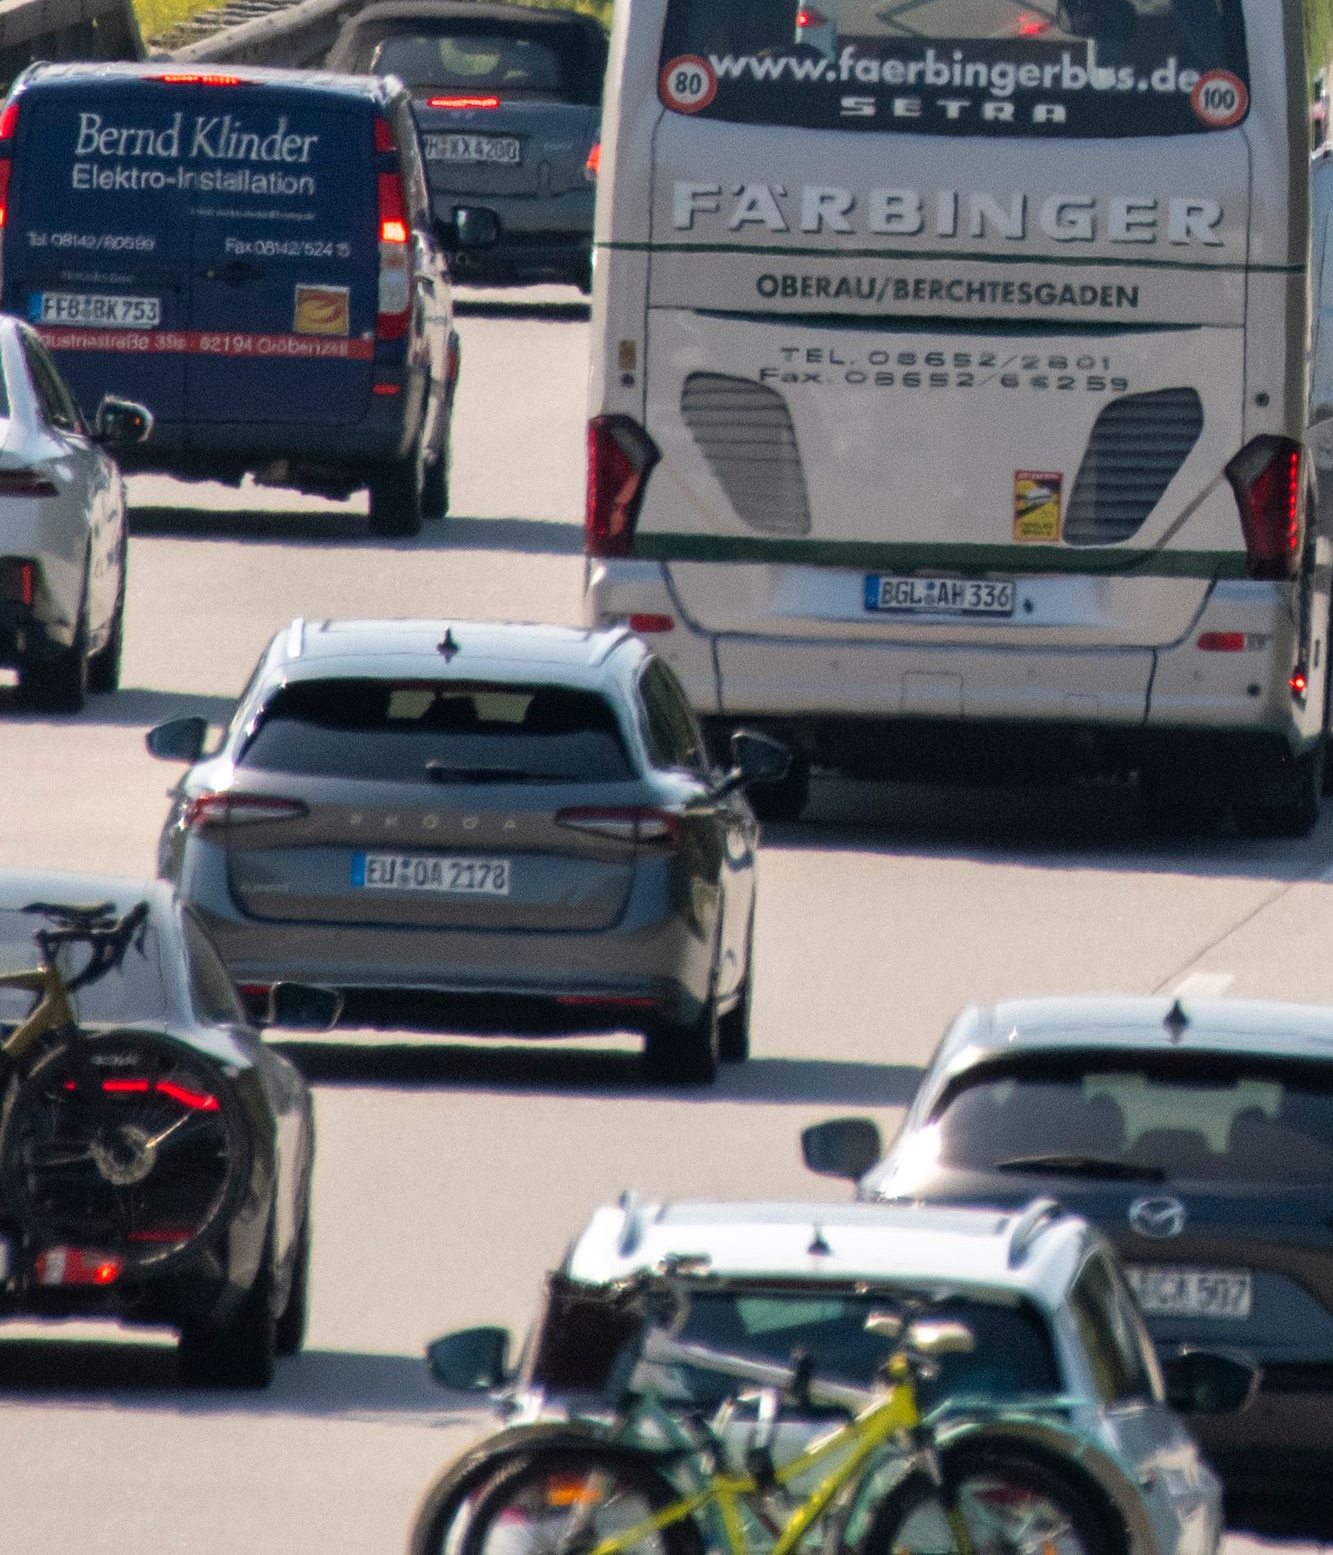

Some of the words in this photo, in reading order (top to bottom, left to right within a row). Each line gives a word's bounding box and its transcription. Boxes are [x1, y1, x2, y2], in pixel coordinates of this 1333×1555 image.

[674, 71, 703, 96] 80
[838, 96, 1067, 124] SETRA
[1203, 88, 1236, 111] 100
[74, 111, 183, 158] Bernd
[189, 114, 319, 163] Klinder
[71, 162, 317, 196] Elektro-Installation
[672, 179, 1225, 246] FÄRBINGER
[756, 272, 1140, 310] OBERAU/BERCHTESGADEN
[121, 300, 158, 323] 753
[780, 346, 856, 367] TEL.
[968, 583, 1011, 609] 336
